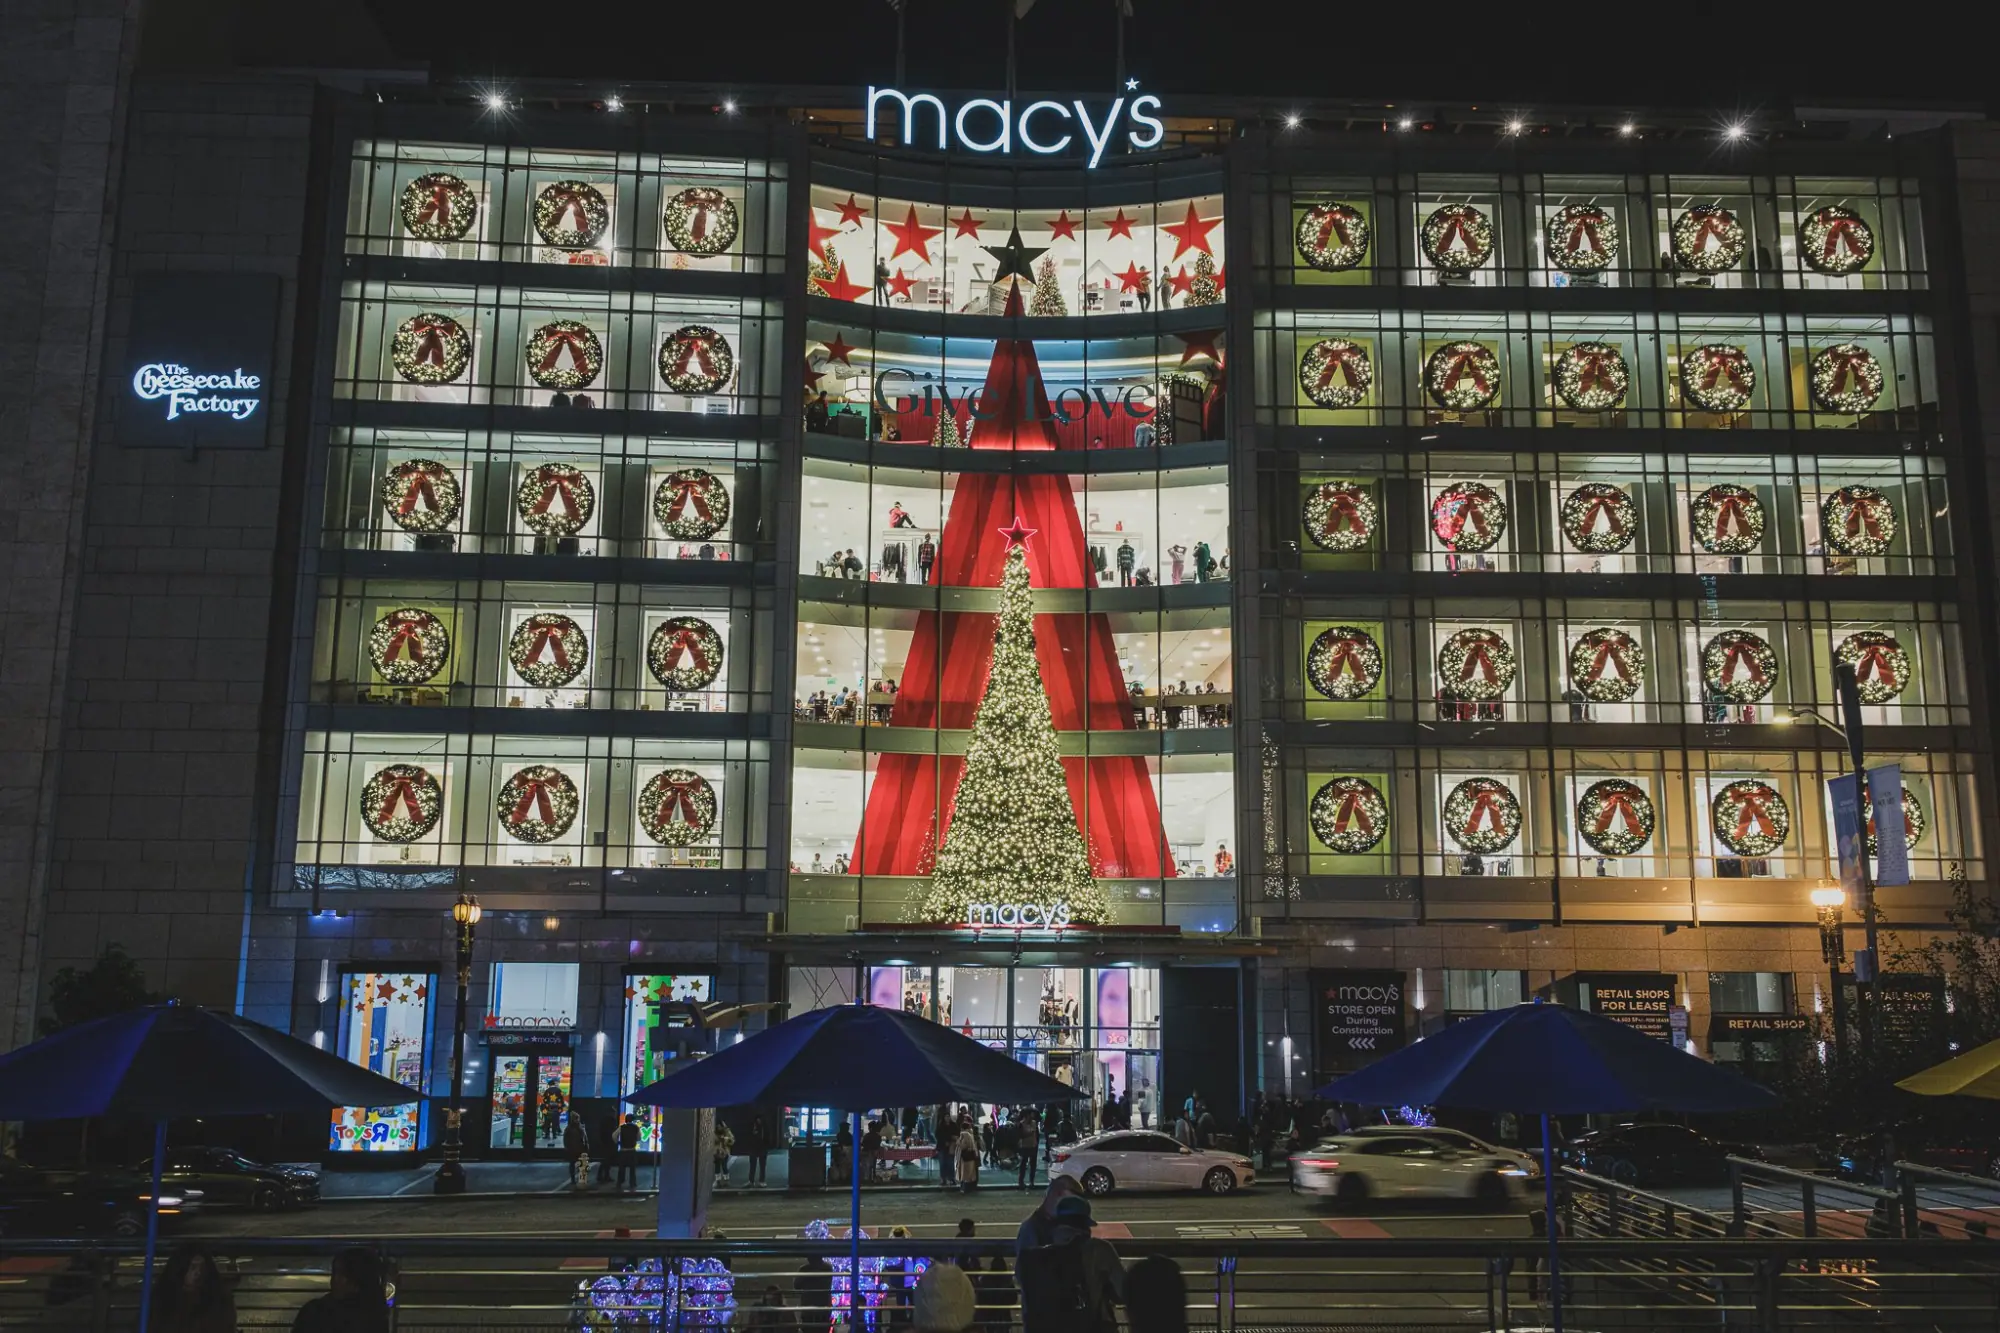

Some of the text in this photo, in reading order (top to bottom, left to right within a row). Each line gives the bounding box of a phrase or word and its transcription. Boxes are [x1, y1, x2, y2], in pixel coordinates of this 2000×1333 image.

[165, 363, 189, 375] The
[133, 363, 261, 399] Cheesecake
[875, 367, 1156, 422] Give Love
[160, 388, 260, 420] Factory
[1596, 989, 1670, 999] RETAIL SHOPS
[1328, 1005, 1396, 1015] STORE OPEN
[1601, 1001, 1667, 1011] FOR LEASE
[1346, 1016, 1378, 1026] During
[1728, 1019, 1806, 1029] RETAIL SHOP
[1331, 1026, 1394, 1035] Construction
